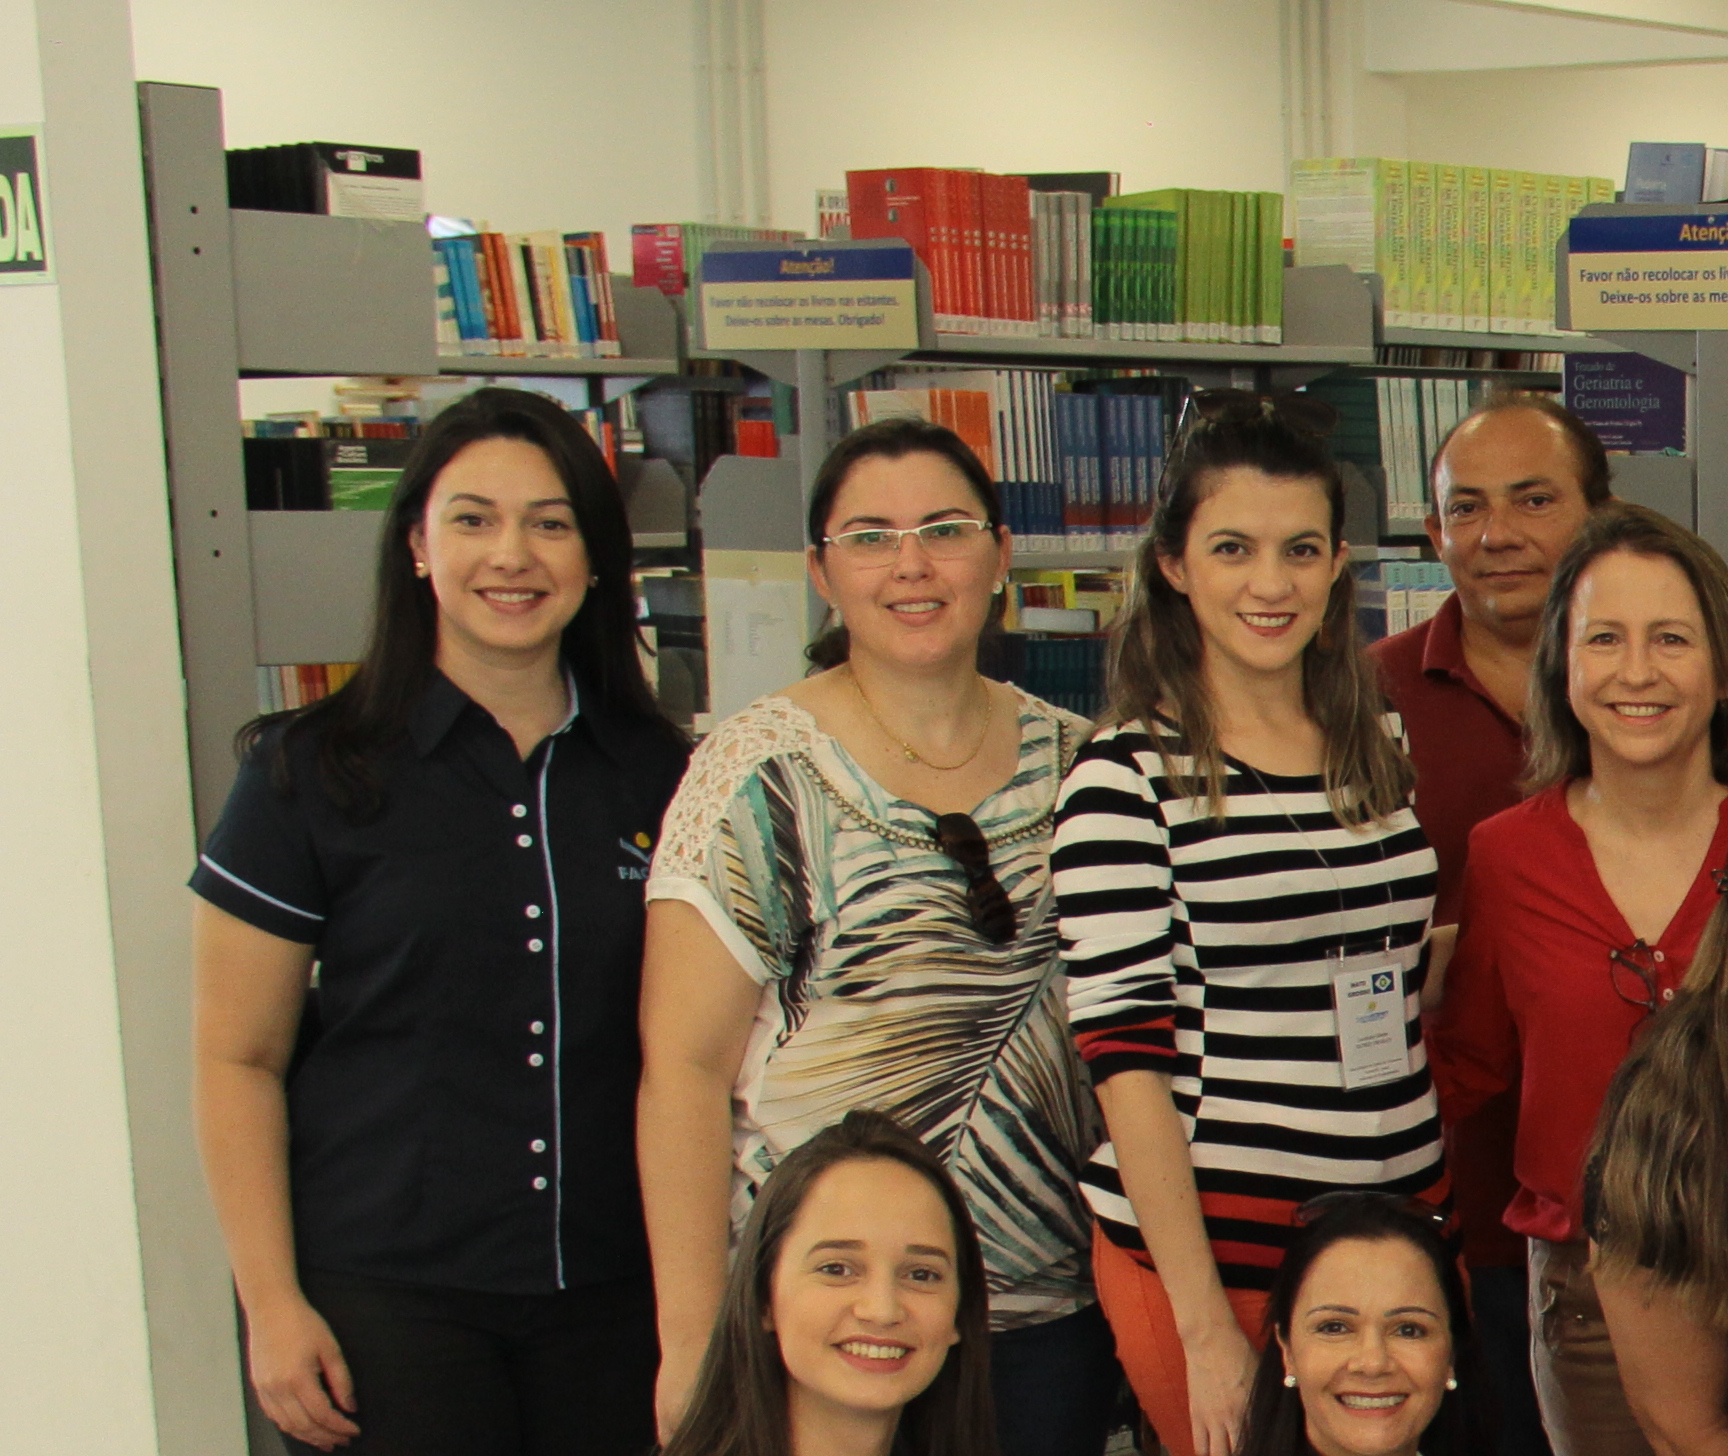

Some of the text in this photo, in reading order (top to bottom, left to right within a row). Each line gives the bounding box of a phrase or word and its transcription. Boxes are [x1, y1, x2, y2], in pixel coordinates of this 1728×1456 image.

[779, 257, 835, 277] Atenção!
[1580, 269, 1613, 282] Favor
[1617, 267, 1639, 282] não
[1643, 267, 1698, 282] recolocar
[1703, 270, 1716, 281] os
[709, 294, 899, 307] Favor não recolocar os livros nas estantes.
[1600, 290, 1651, 304] Deixe-os
[1655, 289, 1689, 303] sobre
[1693, 292, 1706, 303] as
[725, 313, 884, 329] Deixe-os sobre as mesas. Obrigado!
[1573, 374, 1644, 391] Geriatria e
[1574, 393, 1661, 413] Gerontologia
